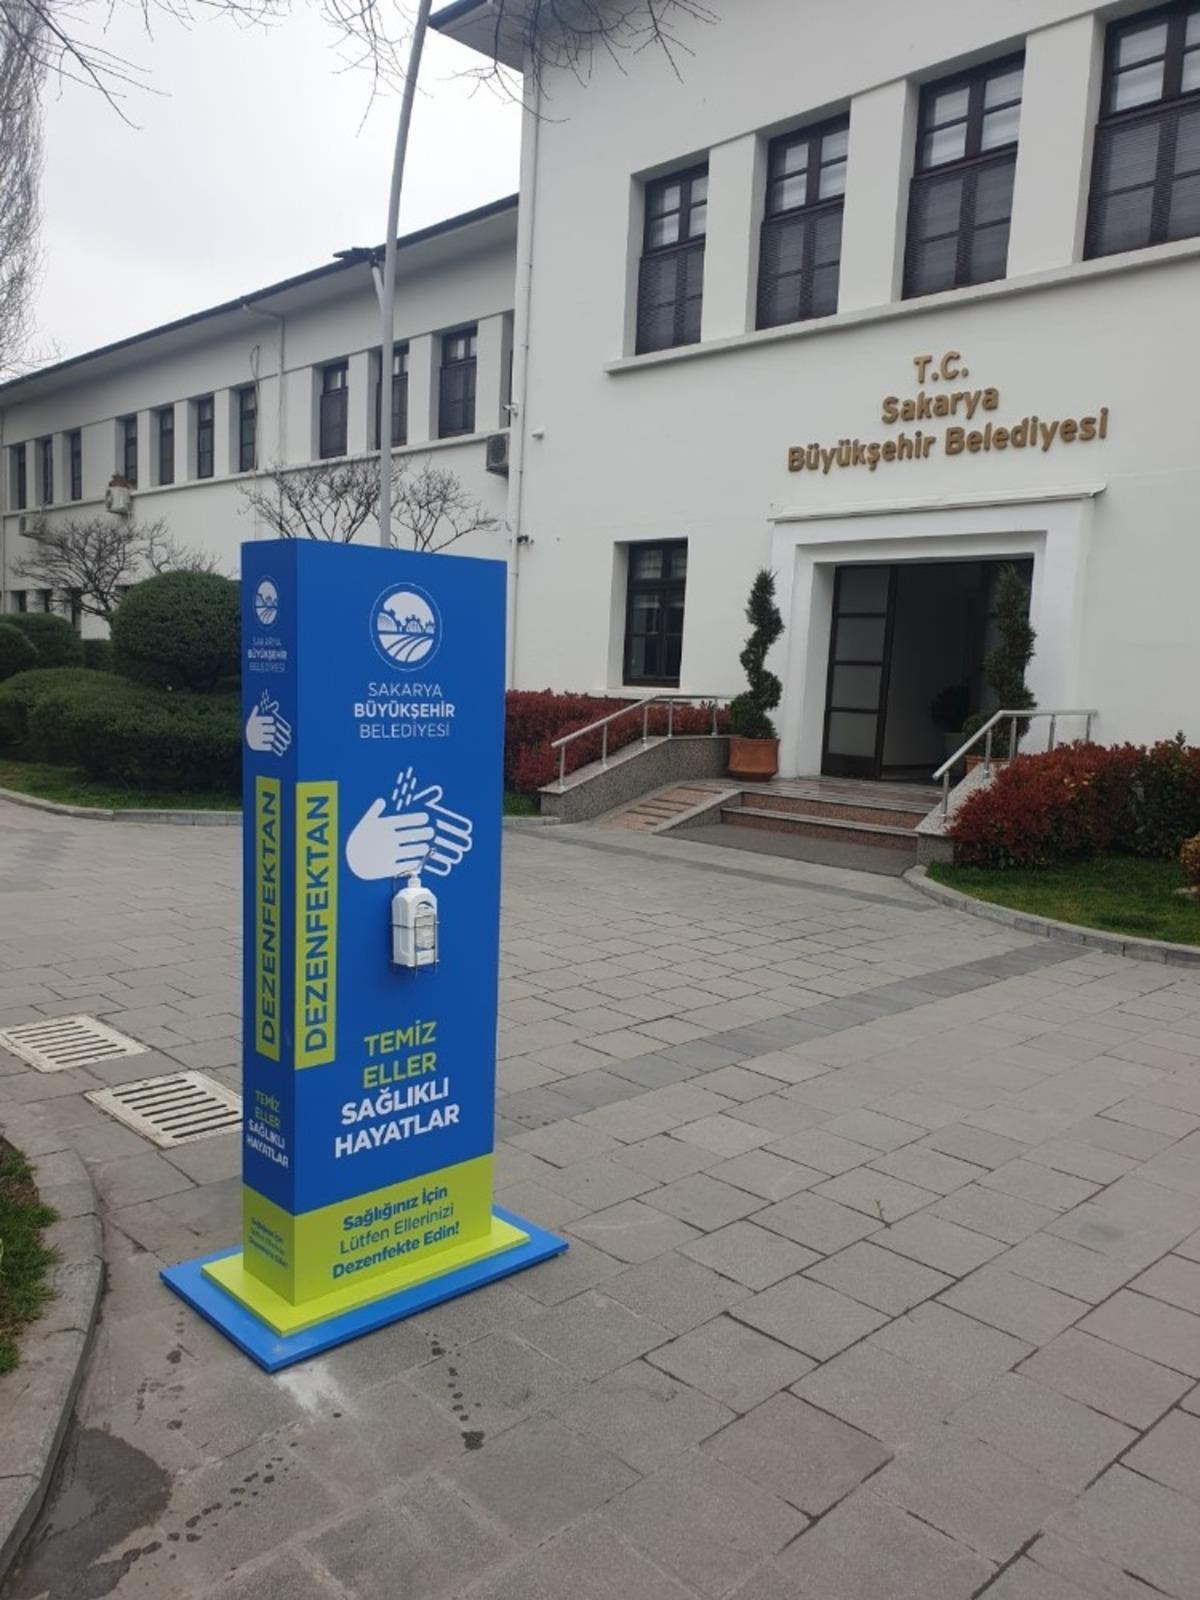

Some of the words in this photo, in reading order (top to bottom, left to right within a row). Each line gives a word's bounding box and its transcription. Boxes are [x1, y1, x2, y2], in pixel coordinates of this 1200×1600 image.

[913, 351, 969, 384] T.C.
[881, 387, 999, 424] Sakarya
[787, 430, 936, 474] Büyükşehir
[944, 406, 1109, 455] Belediyesi
[368, 682, 443, 698] SAKARYA
[353, 700, 456, 719] BÜYÜKŞEHİR
[359, 722, 450, 739] BELEDİYESİ
[261, 791, 276, 1046] DEZENFEKTAN
[305, 795, 330, 1053] DEZENFEKTAN
[363, 1019, 437, 1057] TEMİZ
[363, 1051, 437, 1089] ELLER
[341, 1076, 450, 1126] SAĞLIKLI
[334, 1103, 461, 1159] HAYATLAR
[247, 1135, 289, 1169] HAYATLAR
[340, 1226, 390, 1254] Lütfen
[394, 1202, 454, 1235] Ellerinizi
[343, 1196, 419, 1231] Sağlığınız
[332, 1238, 420, 1279] Dezenfekte
[423, 1220, 460, 1246] Edin!
